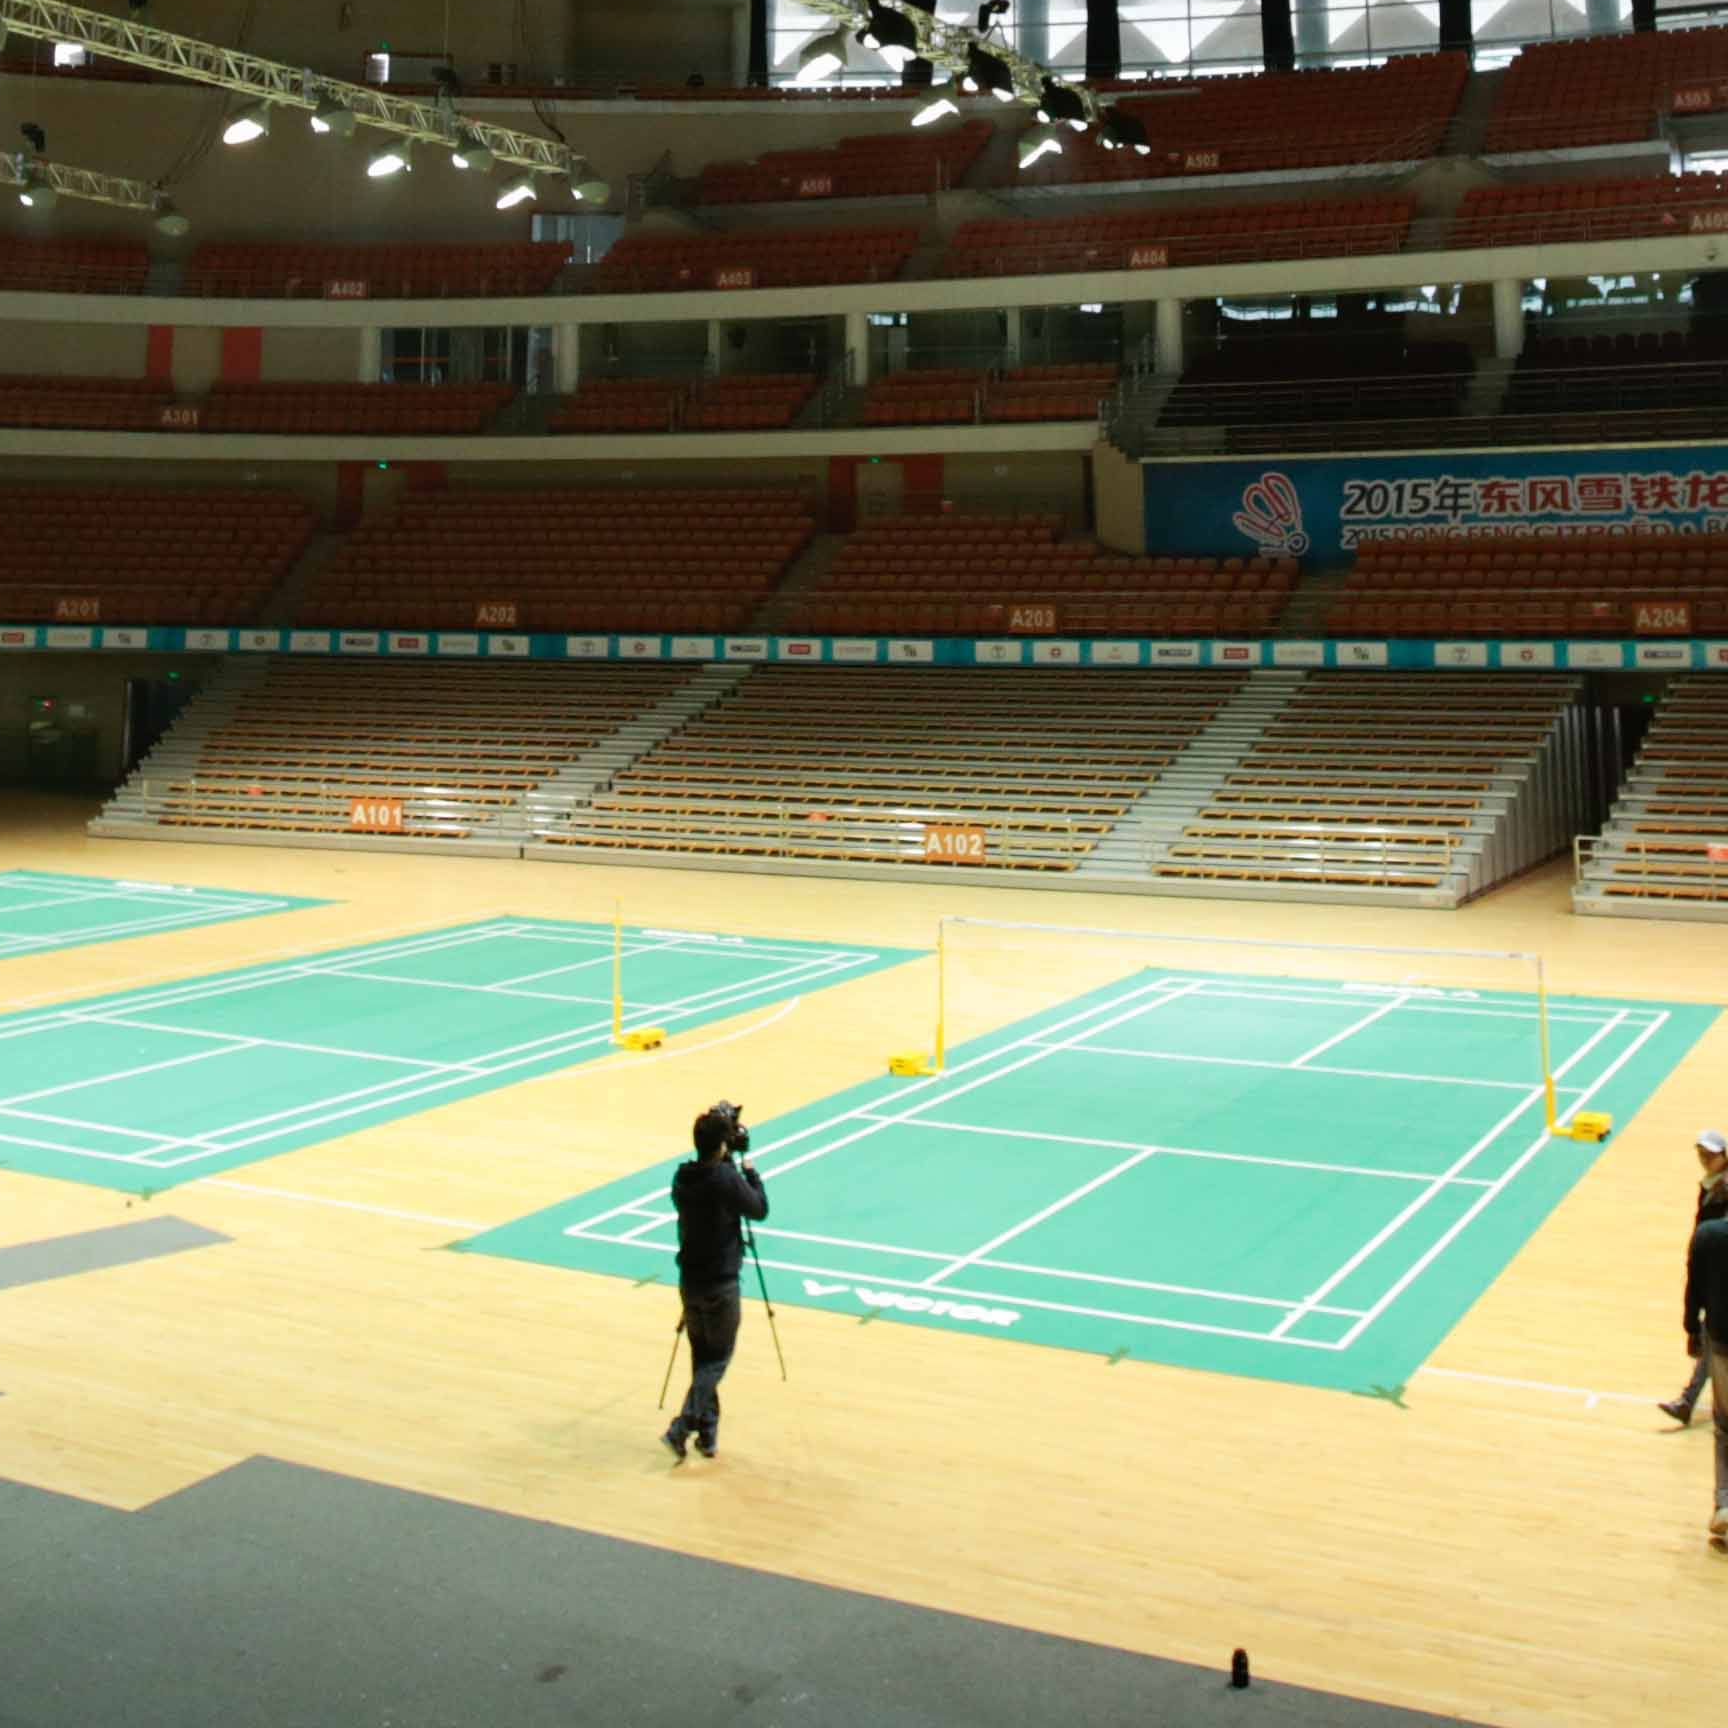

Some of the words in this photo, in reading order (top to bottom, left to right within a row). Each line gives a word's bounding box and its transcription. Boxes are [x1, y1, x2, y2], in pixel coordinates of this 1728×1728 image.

[161, 408, 199, 424] A301
[1345, 527, 1390, 546] 2015
[57, 600, 100, 618] A201
[477, 605, 516, 624] A202
[1011, 608, 1056, 627] A203
[1636, 608, 1688, 629] A204
[353, 805, 403, 826] A101
[926, 832, 983, 856] A102
